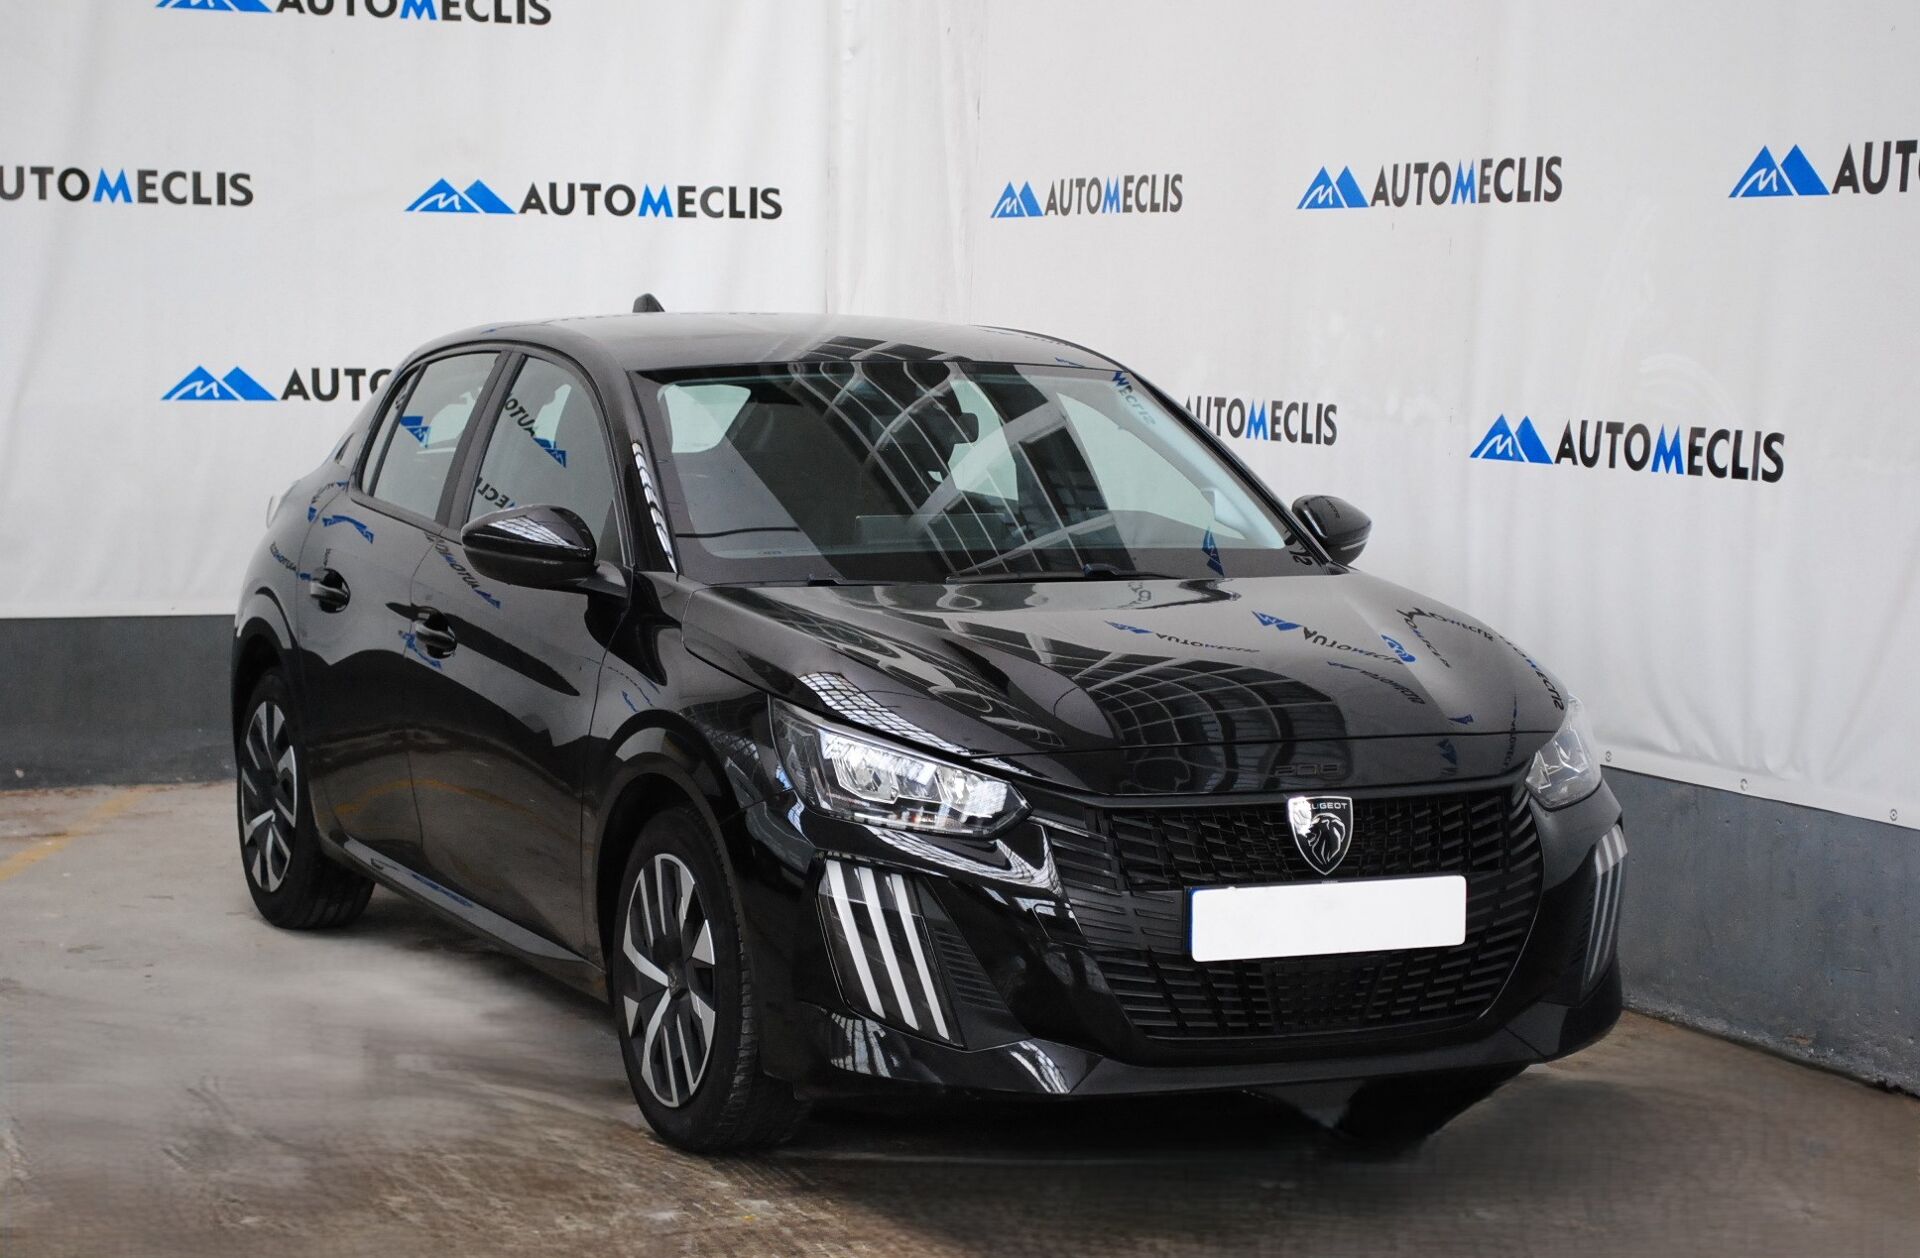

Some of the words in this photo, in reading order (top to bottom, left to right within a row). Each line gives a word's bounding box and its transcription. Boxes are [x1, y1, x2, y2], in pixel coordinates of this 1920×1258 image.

[1370, 155, 1564, 208] AUTOMECLIS
[1831, 139, 1920, 195] AUT
[519, 182, 783, 220] AUTOMECLIS
[1044, 173, 1184, 216] AUTOMECLIS
[1554, 418, 1786, 484] AUTOMECLIS
